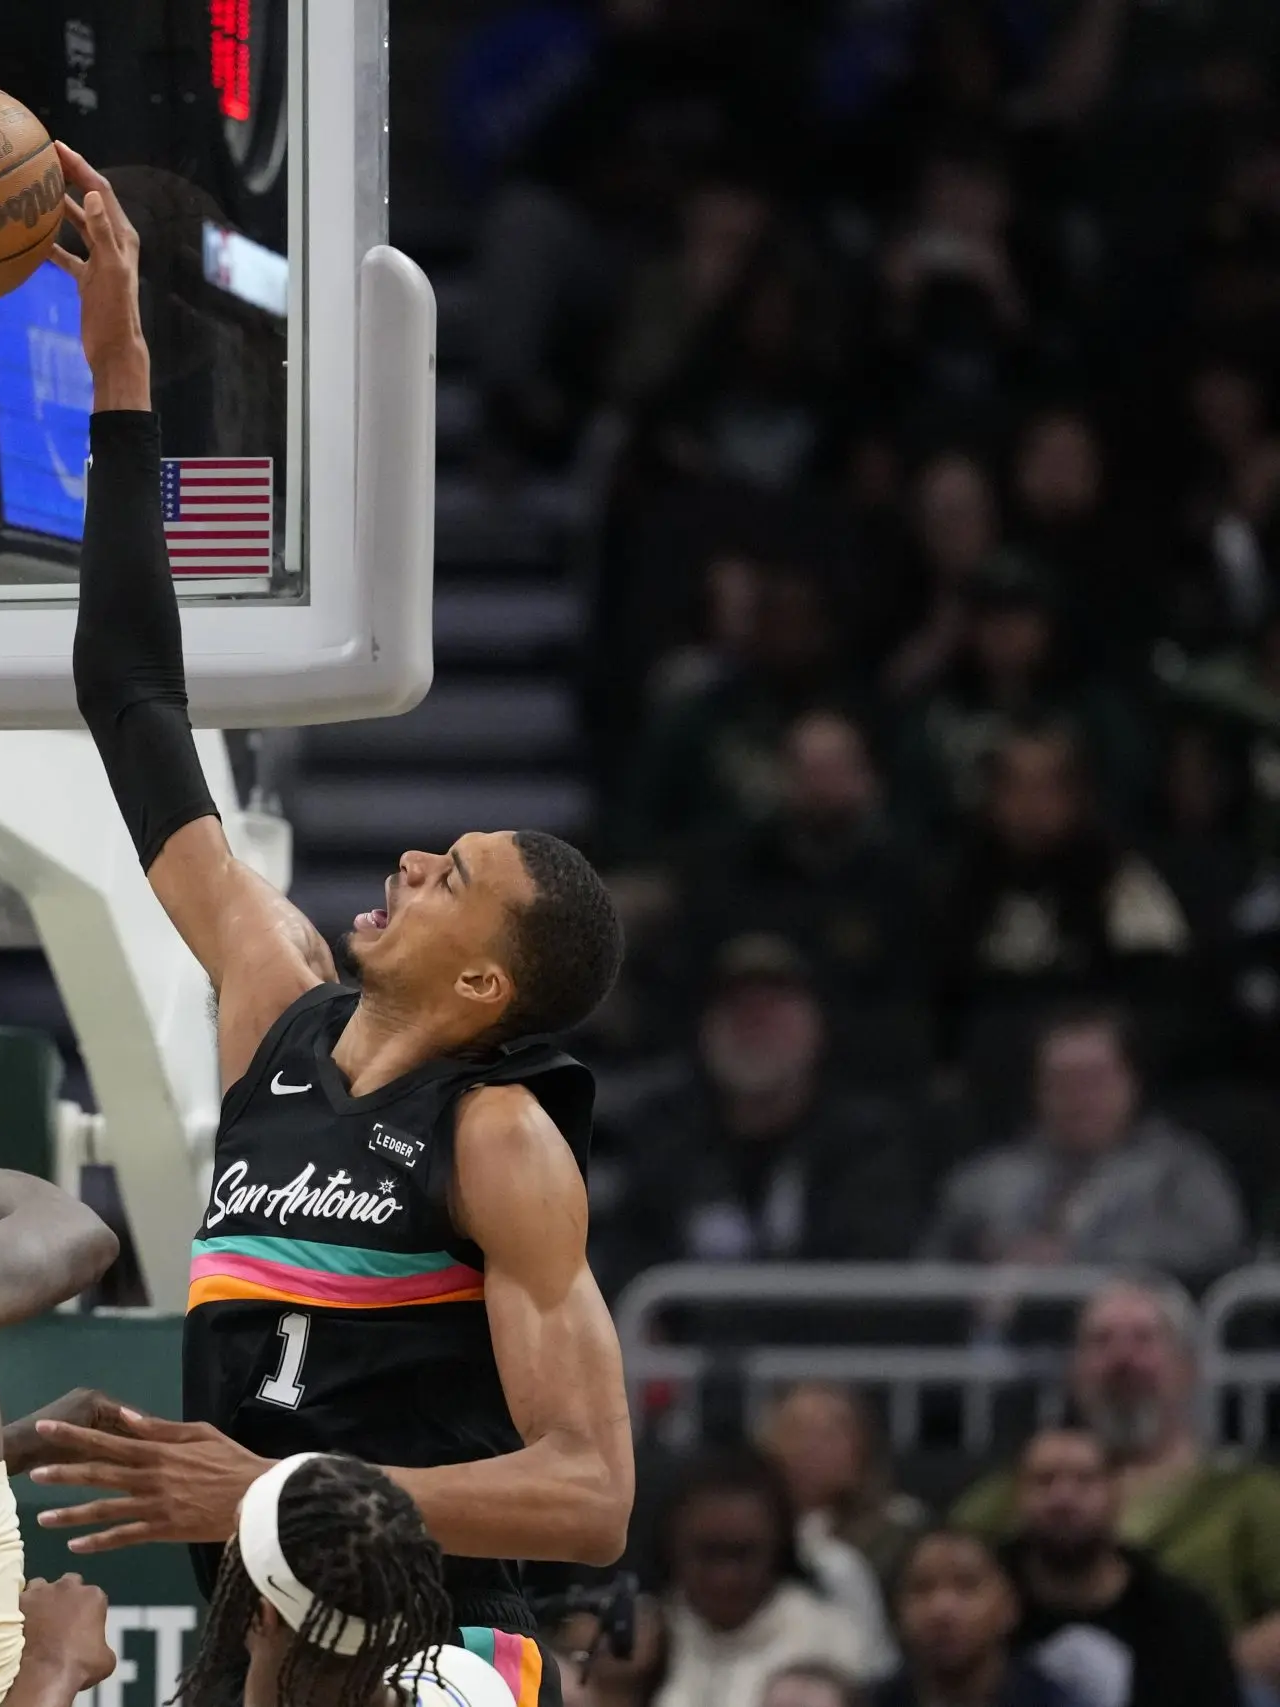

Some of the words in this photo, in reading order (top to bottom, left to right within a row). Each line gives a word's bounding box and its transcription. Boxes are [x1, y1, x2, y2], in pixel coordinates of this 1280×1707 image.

[375, 1132, 414, 1158] LEDGER
[206, 1160, 269, 1230] San
[264, 1162, 403, 1226] Antonio
[255, 1311, 311, 1411] 1
